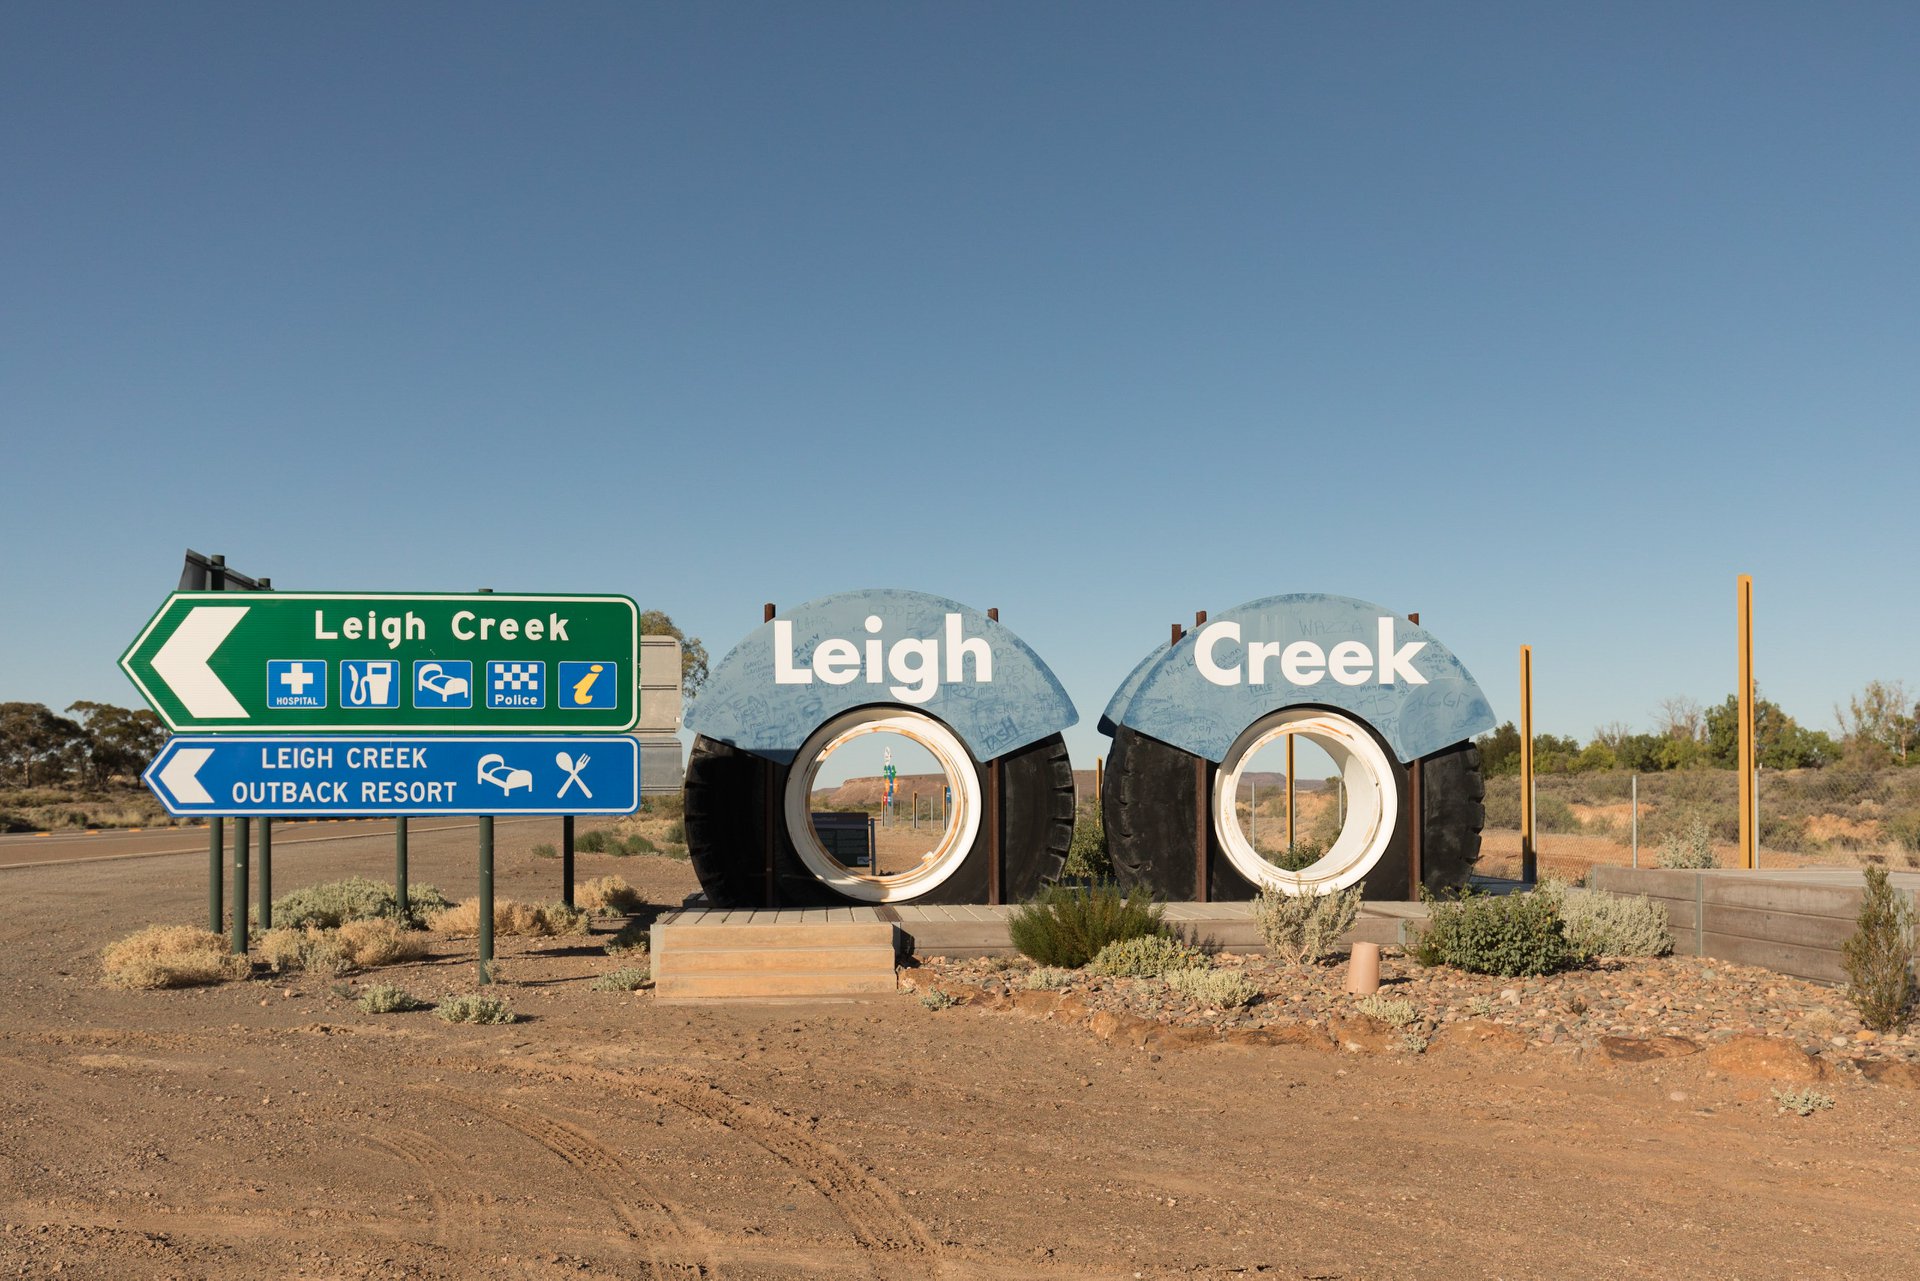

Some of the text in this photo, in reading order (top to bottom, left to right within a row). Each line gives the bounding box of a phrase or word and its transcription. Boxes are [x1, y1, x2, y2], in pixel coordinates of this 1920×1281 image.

[315, 610, 568, 649] Leigh Creek
[774, 613, 992, 703] Leigh
[1194, 617, 1428, 685] Creek
[276, 697, 318, 705] HOSPITAL
[495, 694, 537, 705] Police
[262, 748, 427, 768] LEIGH CREEK
[233, 782, 456, 803] OUTBACK RESORT
